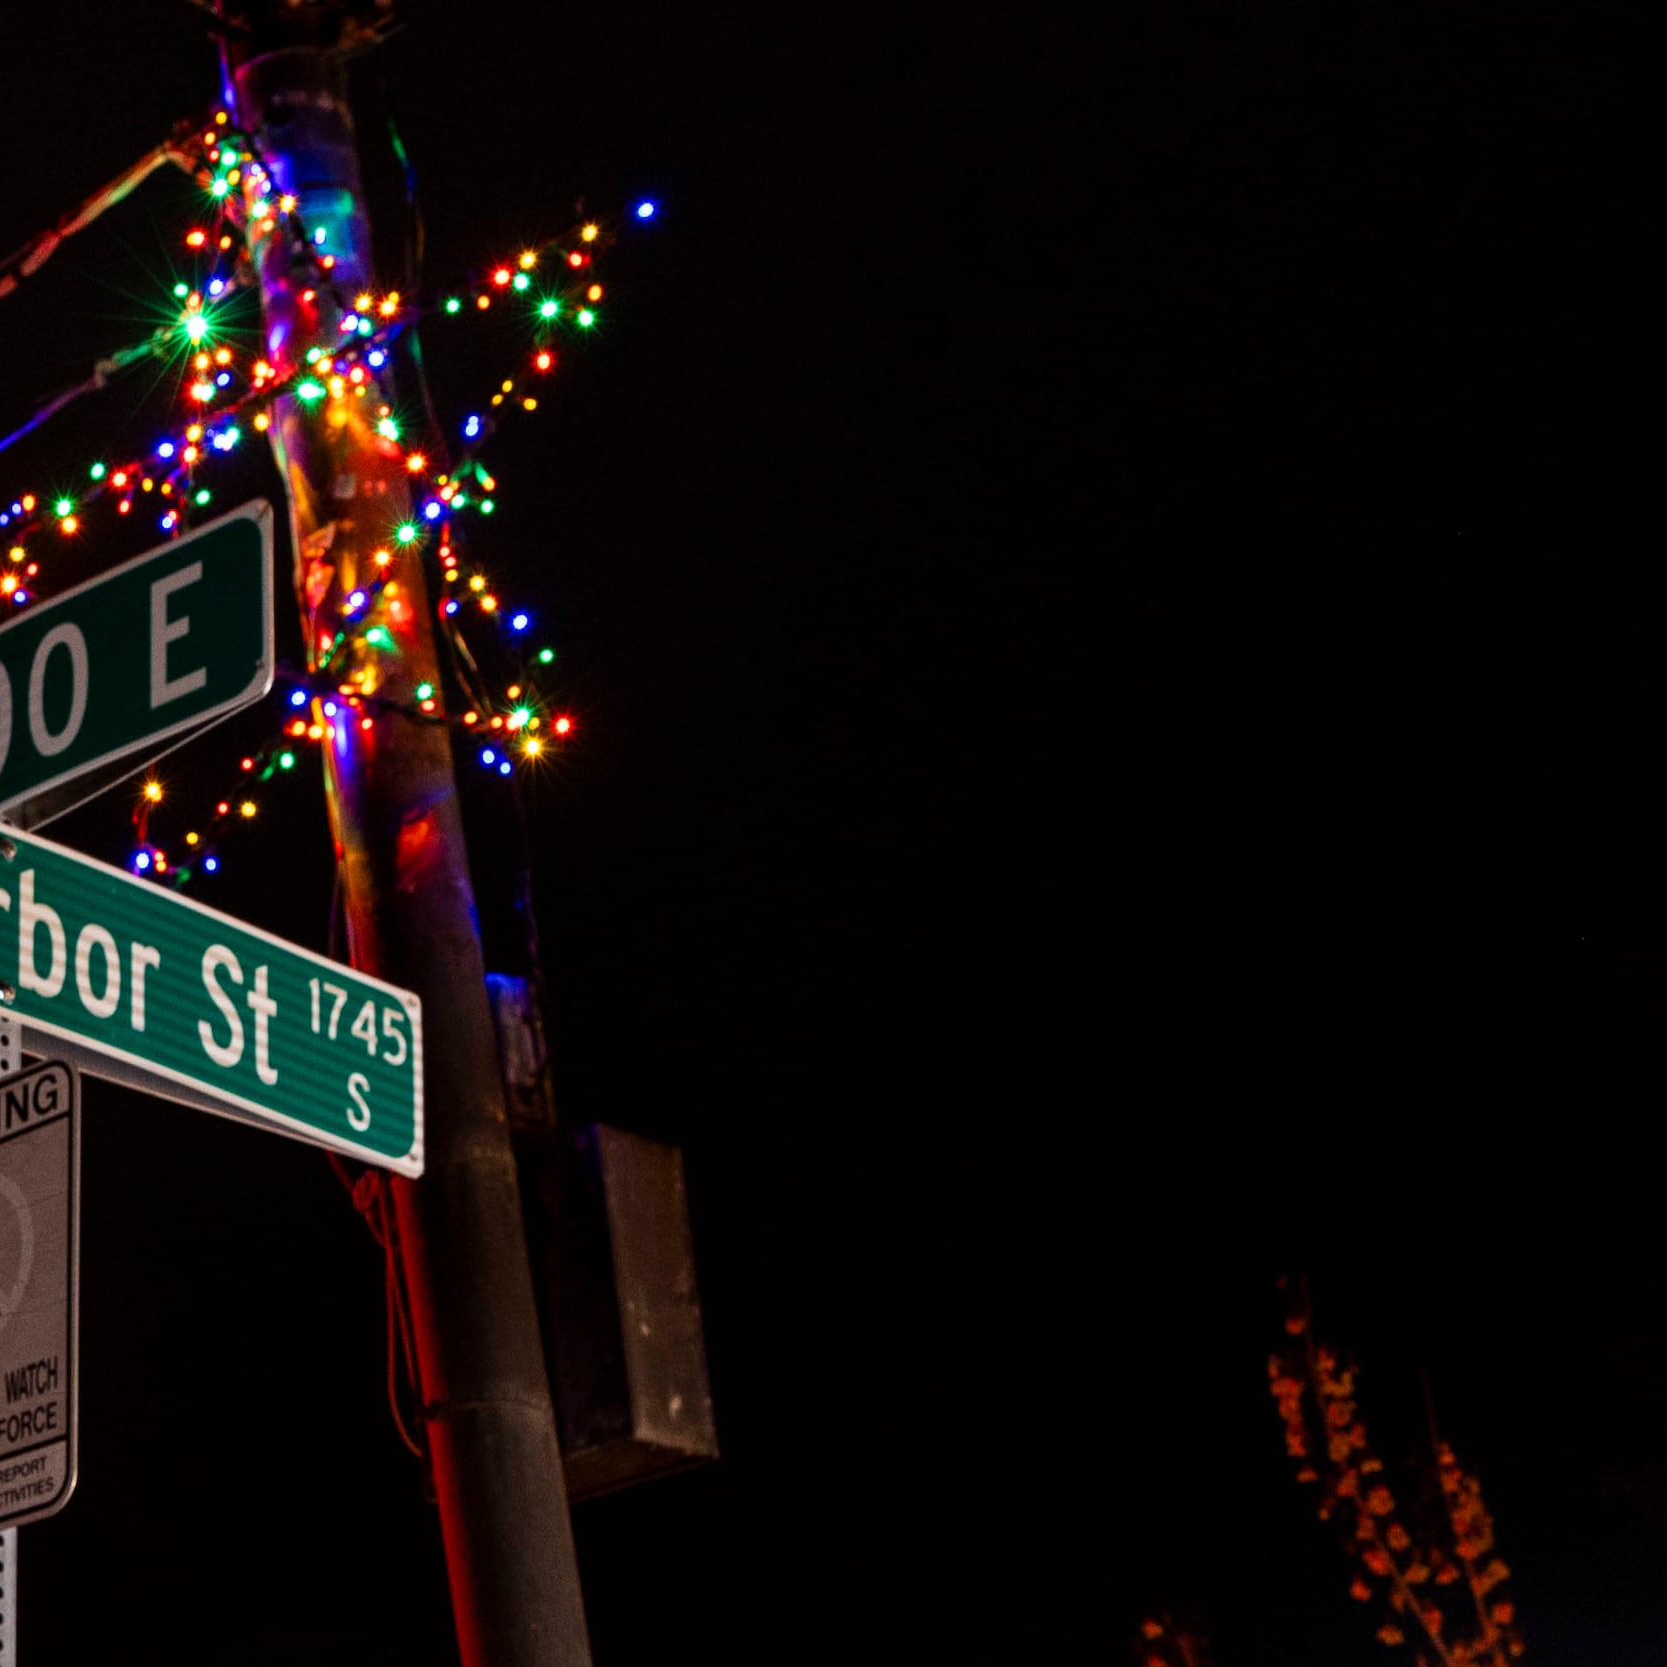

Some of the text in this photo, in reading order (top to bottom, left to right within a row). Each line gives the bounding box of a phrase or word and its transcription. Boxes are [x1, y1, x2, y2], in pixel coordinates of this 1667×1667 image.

[151, 560, 207, 710] E
[197, 944, 278, 1086] St
[309, 978, 407, 1066] 1745
[346, 1072, 371, 1131] S
[5, 1356, 58, 1403] WATCH
